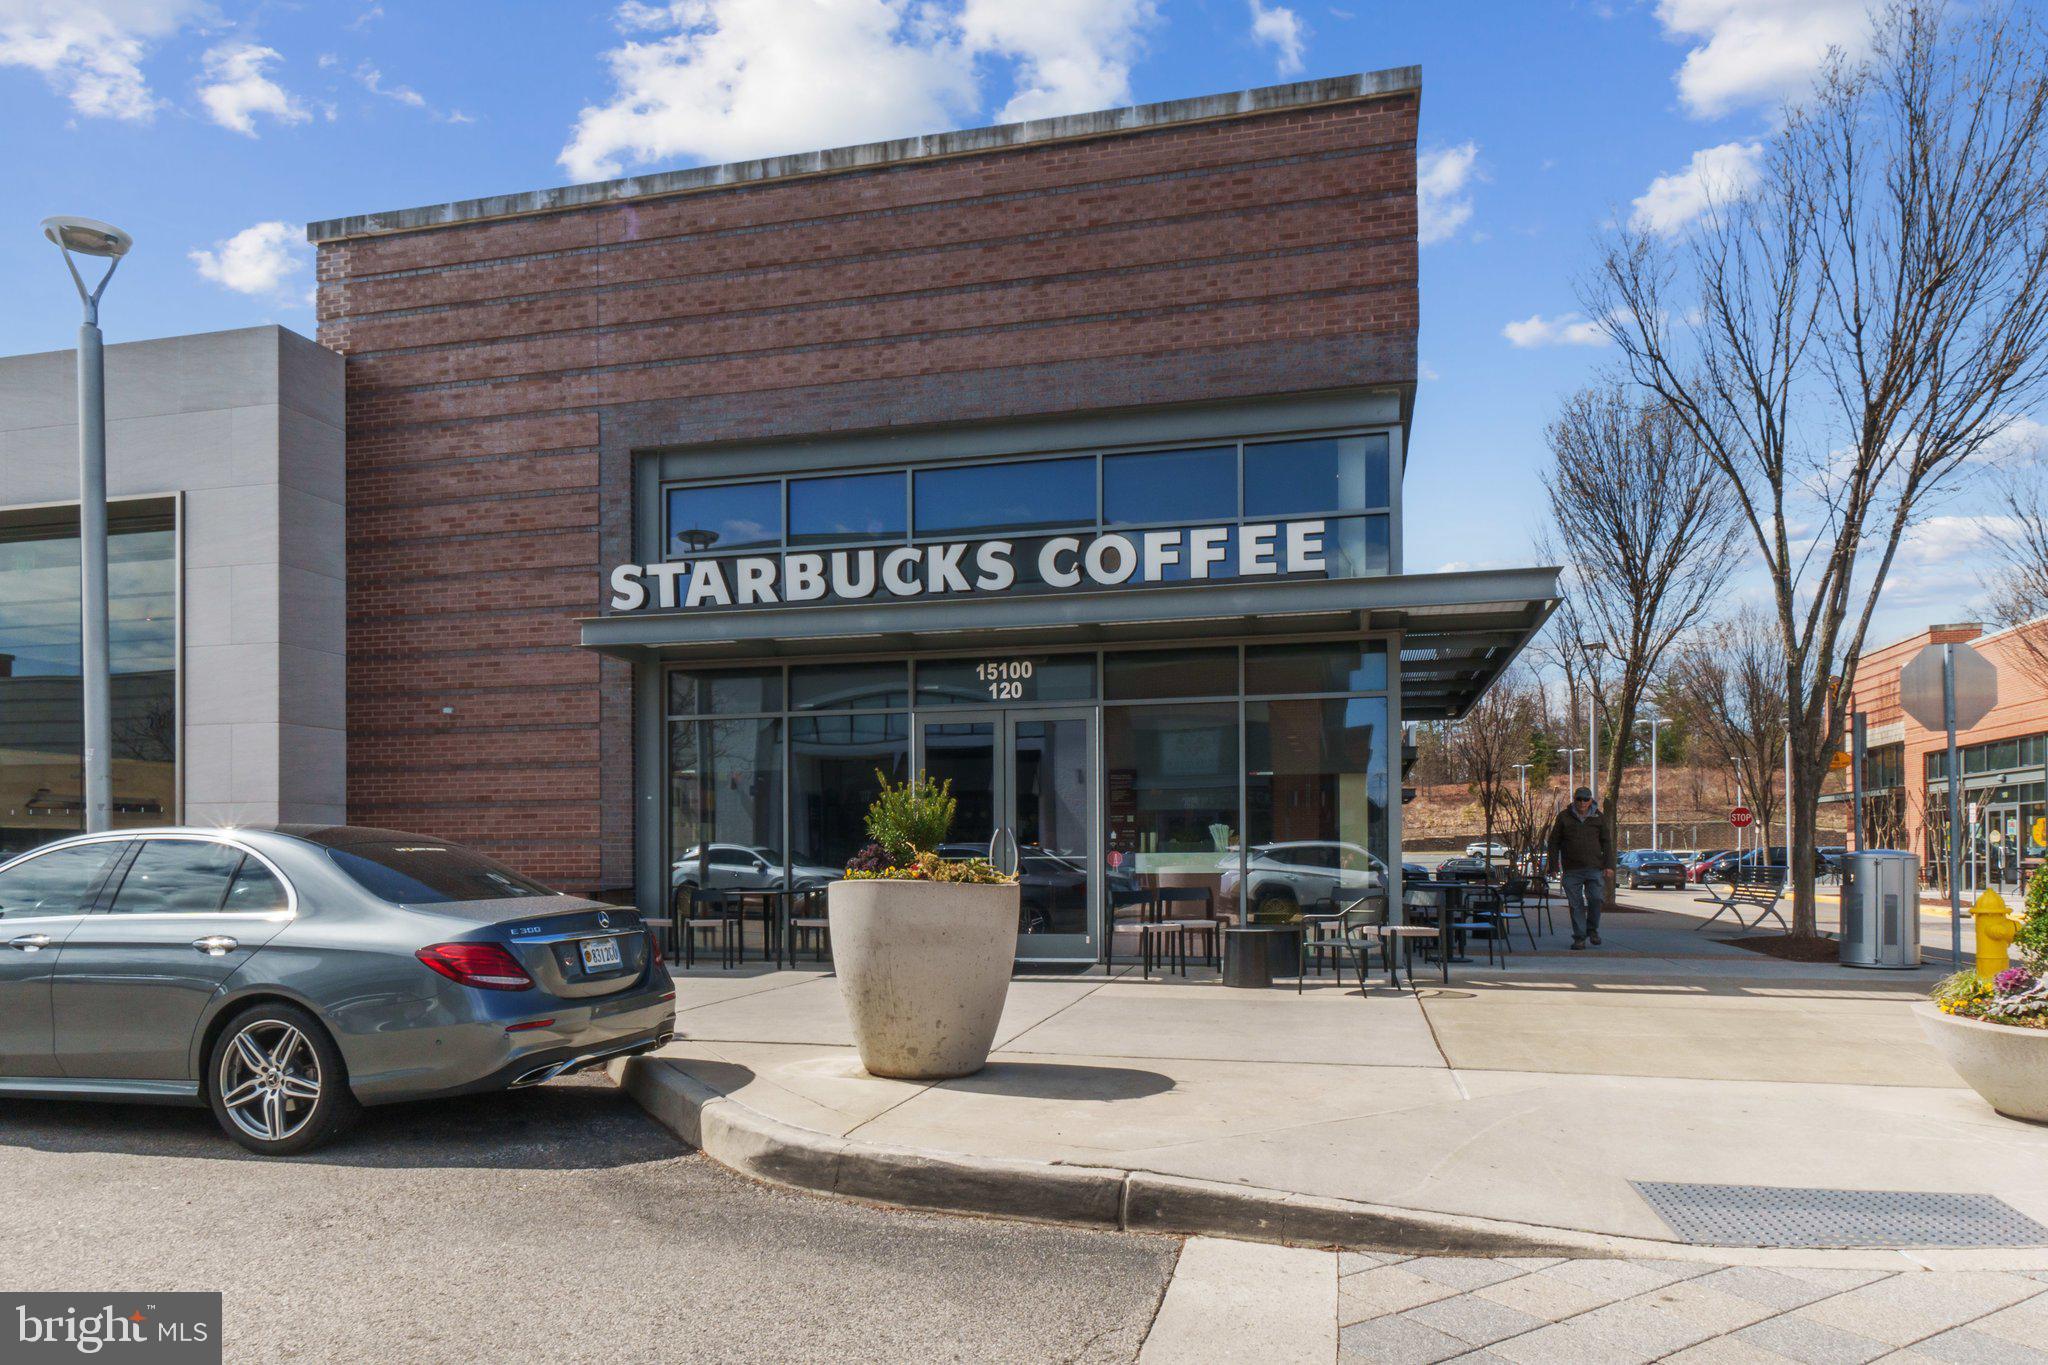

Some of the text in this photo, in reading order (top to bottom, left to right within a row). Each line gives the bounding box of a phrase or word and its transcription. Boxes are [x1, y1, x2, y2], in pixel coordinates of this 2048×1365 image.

[610, 520, 1326, 611] STARBUCKS COFFEE
[976, 661, 1033, 680] 15100
[988, 681, 1023, 699] 120
[1731, 813, 1752, 822] STOP
[511, 926, 542, 936] E 300
